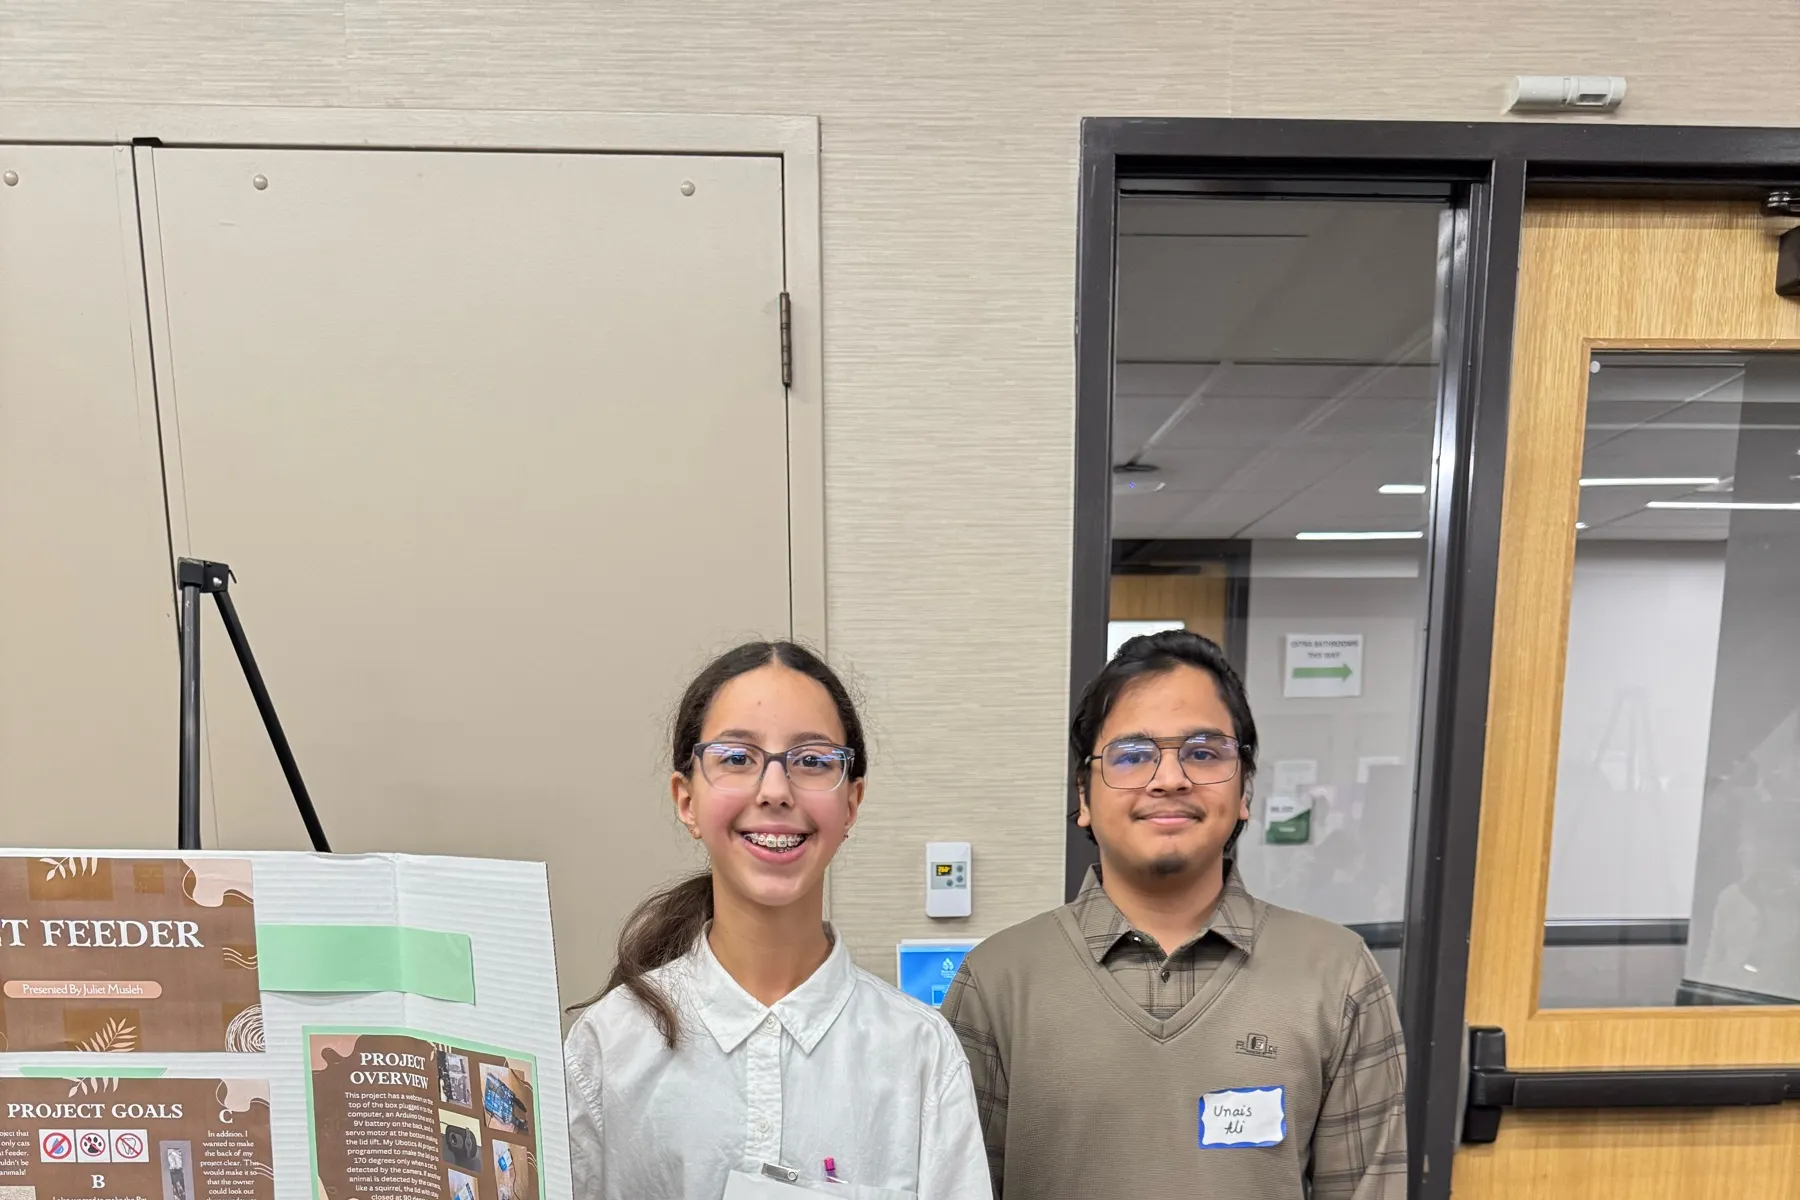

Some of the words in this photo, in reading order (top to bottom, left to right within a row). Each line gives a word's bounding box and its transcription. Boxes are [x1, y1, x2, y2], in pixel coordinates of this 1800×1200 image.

[0, 919, 29, 947] T
[40, 920, 204, 948] FEEDER
[23, 984, 68, 995] Presented
[70, 984, 81, 996] By
[83, 984, 106, 996] Juliet
[108, 985, 143, 995] Musleh
[360, 1053, 425, 1070] PROJECT
[350, 1072, 429, 1090] OVERVIEW
[8, 1104, 105, 1118] PROJECT
[112, 1104, 183, 1119] GOALS
[219, 1109, 233, 1123] C
[1214, 1105, 1252, 1117] Unais
[91, 1175, 105, 1188] B
